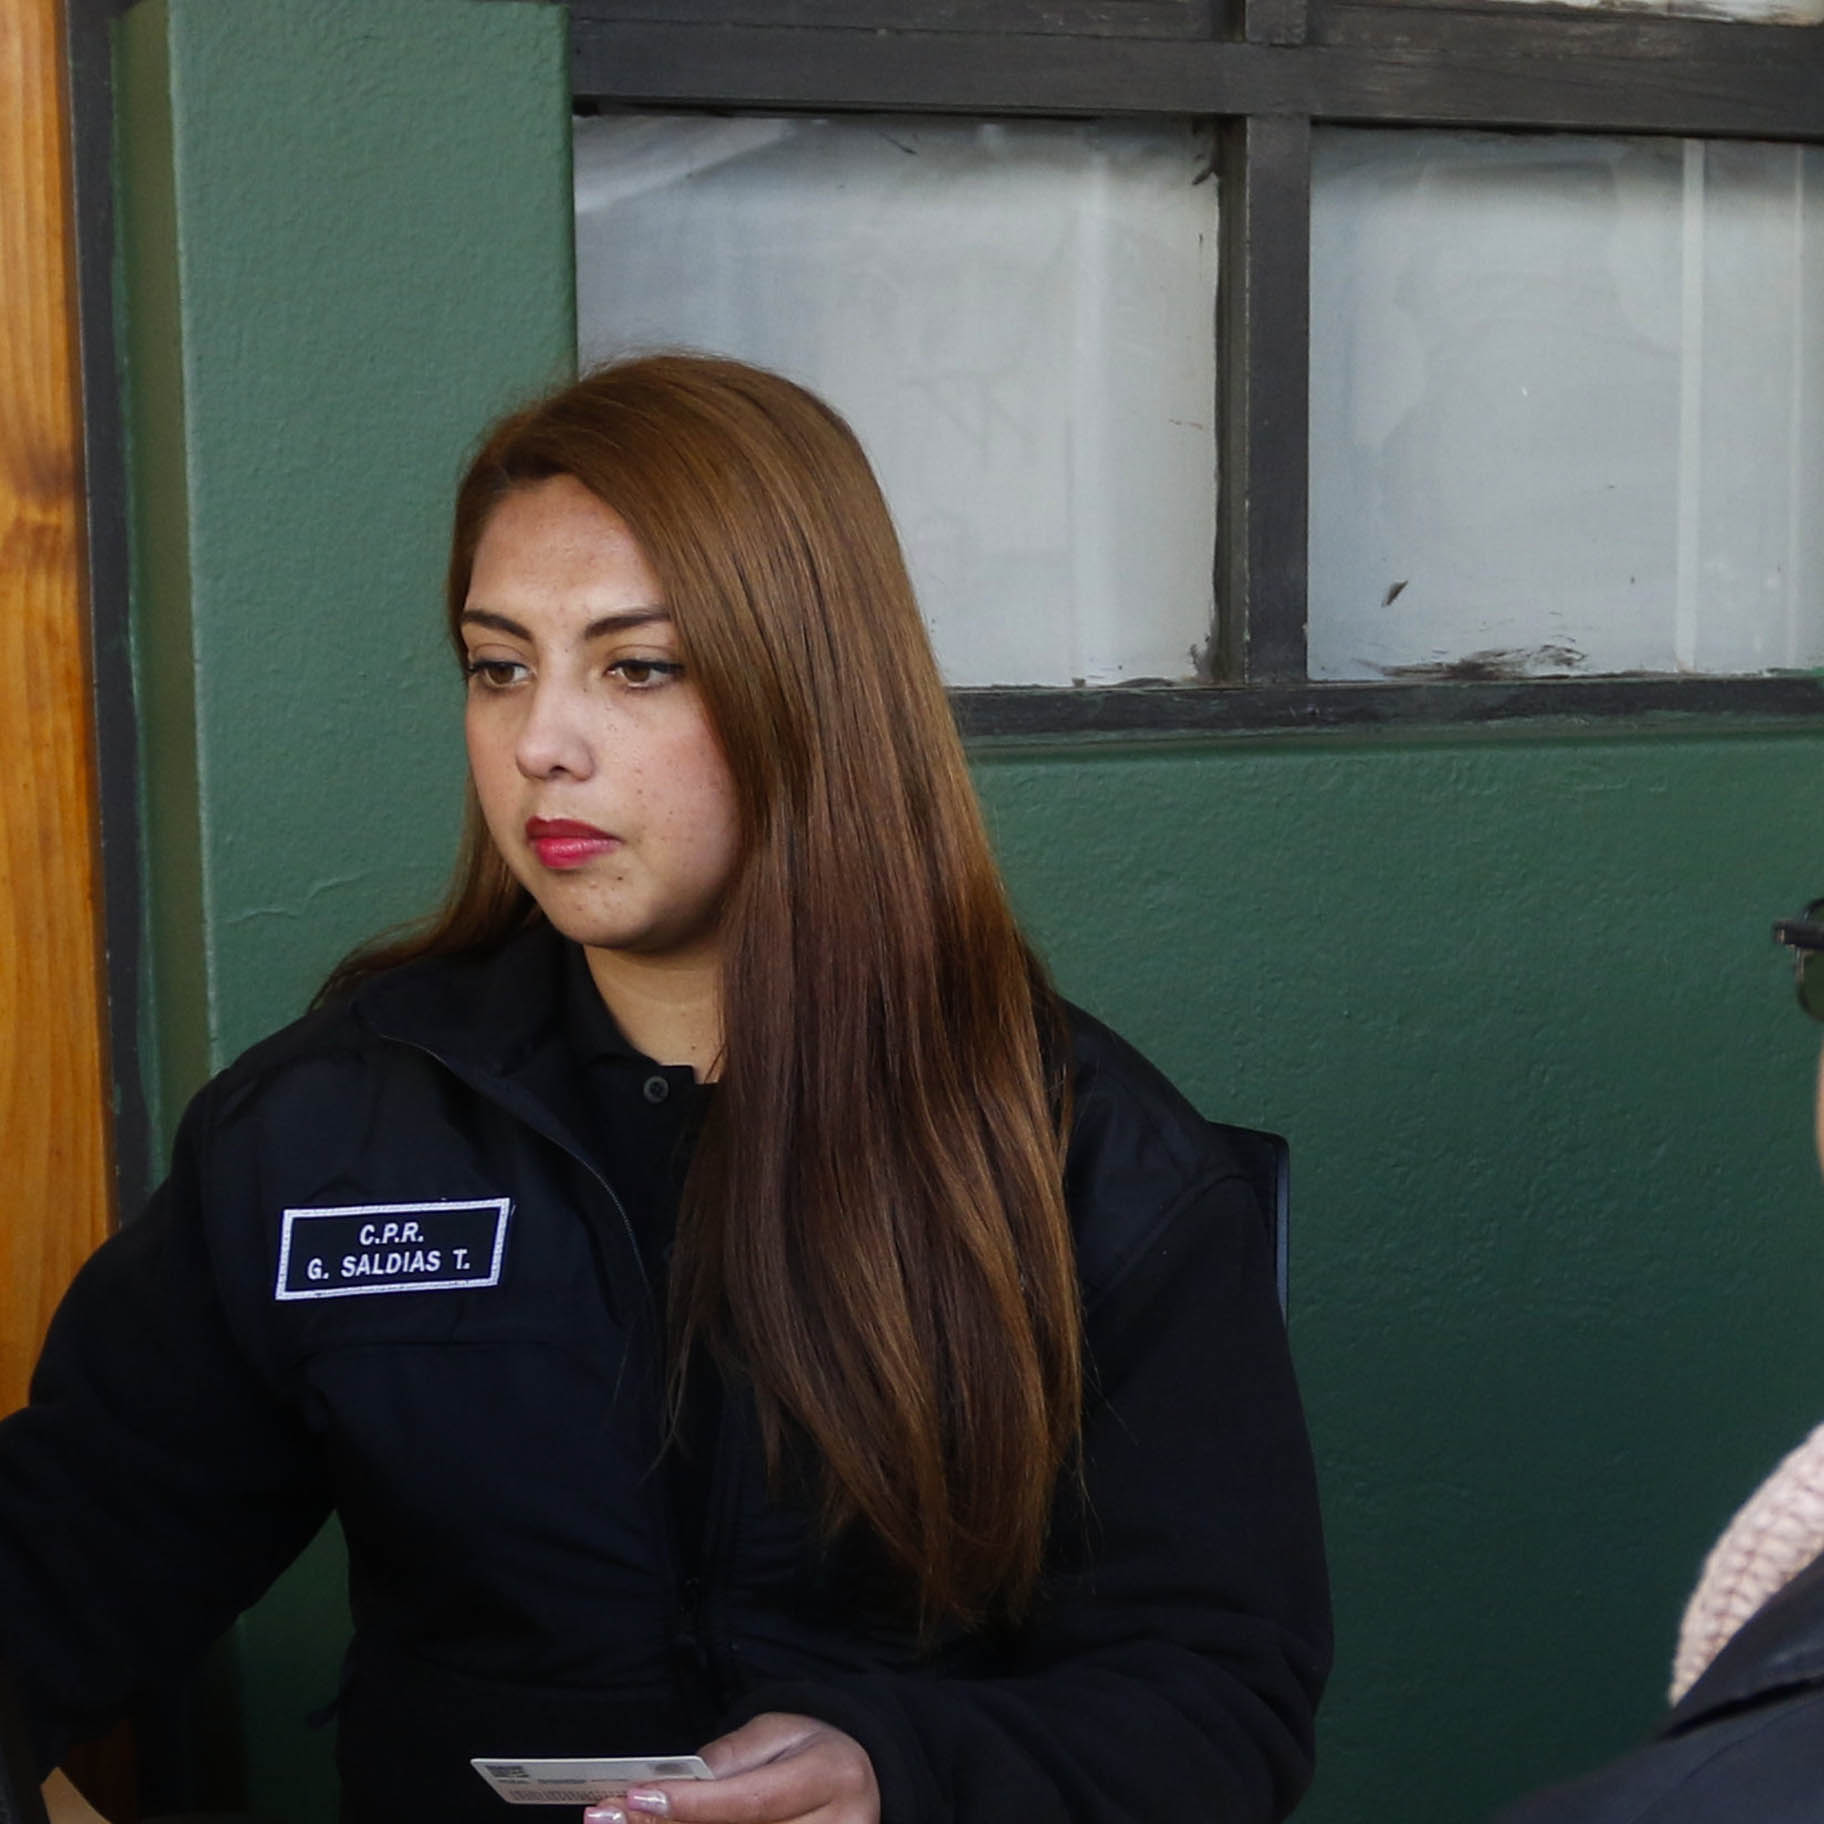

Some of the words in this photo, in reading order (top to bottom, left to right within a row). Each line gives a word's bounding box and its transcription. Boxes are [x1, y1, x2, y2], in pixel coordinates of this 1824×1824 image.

[359, 1221, 425, 1247] C.P.R.
[307, 1257, 330, 1280] G.
[340, 1250, 442, 1278] SALDIAS
[453, 1248, 471, 1271] T.
